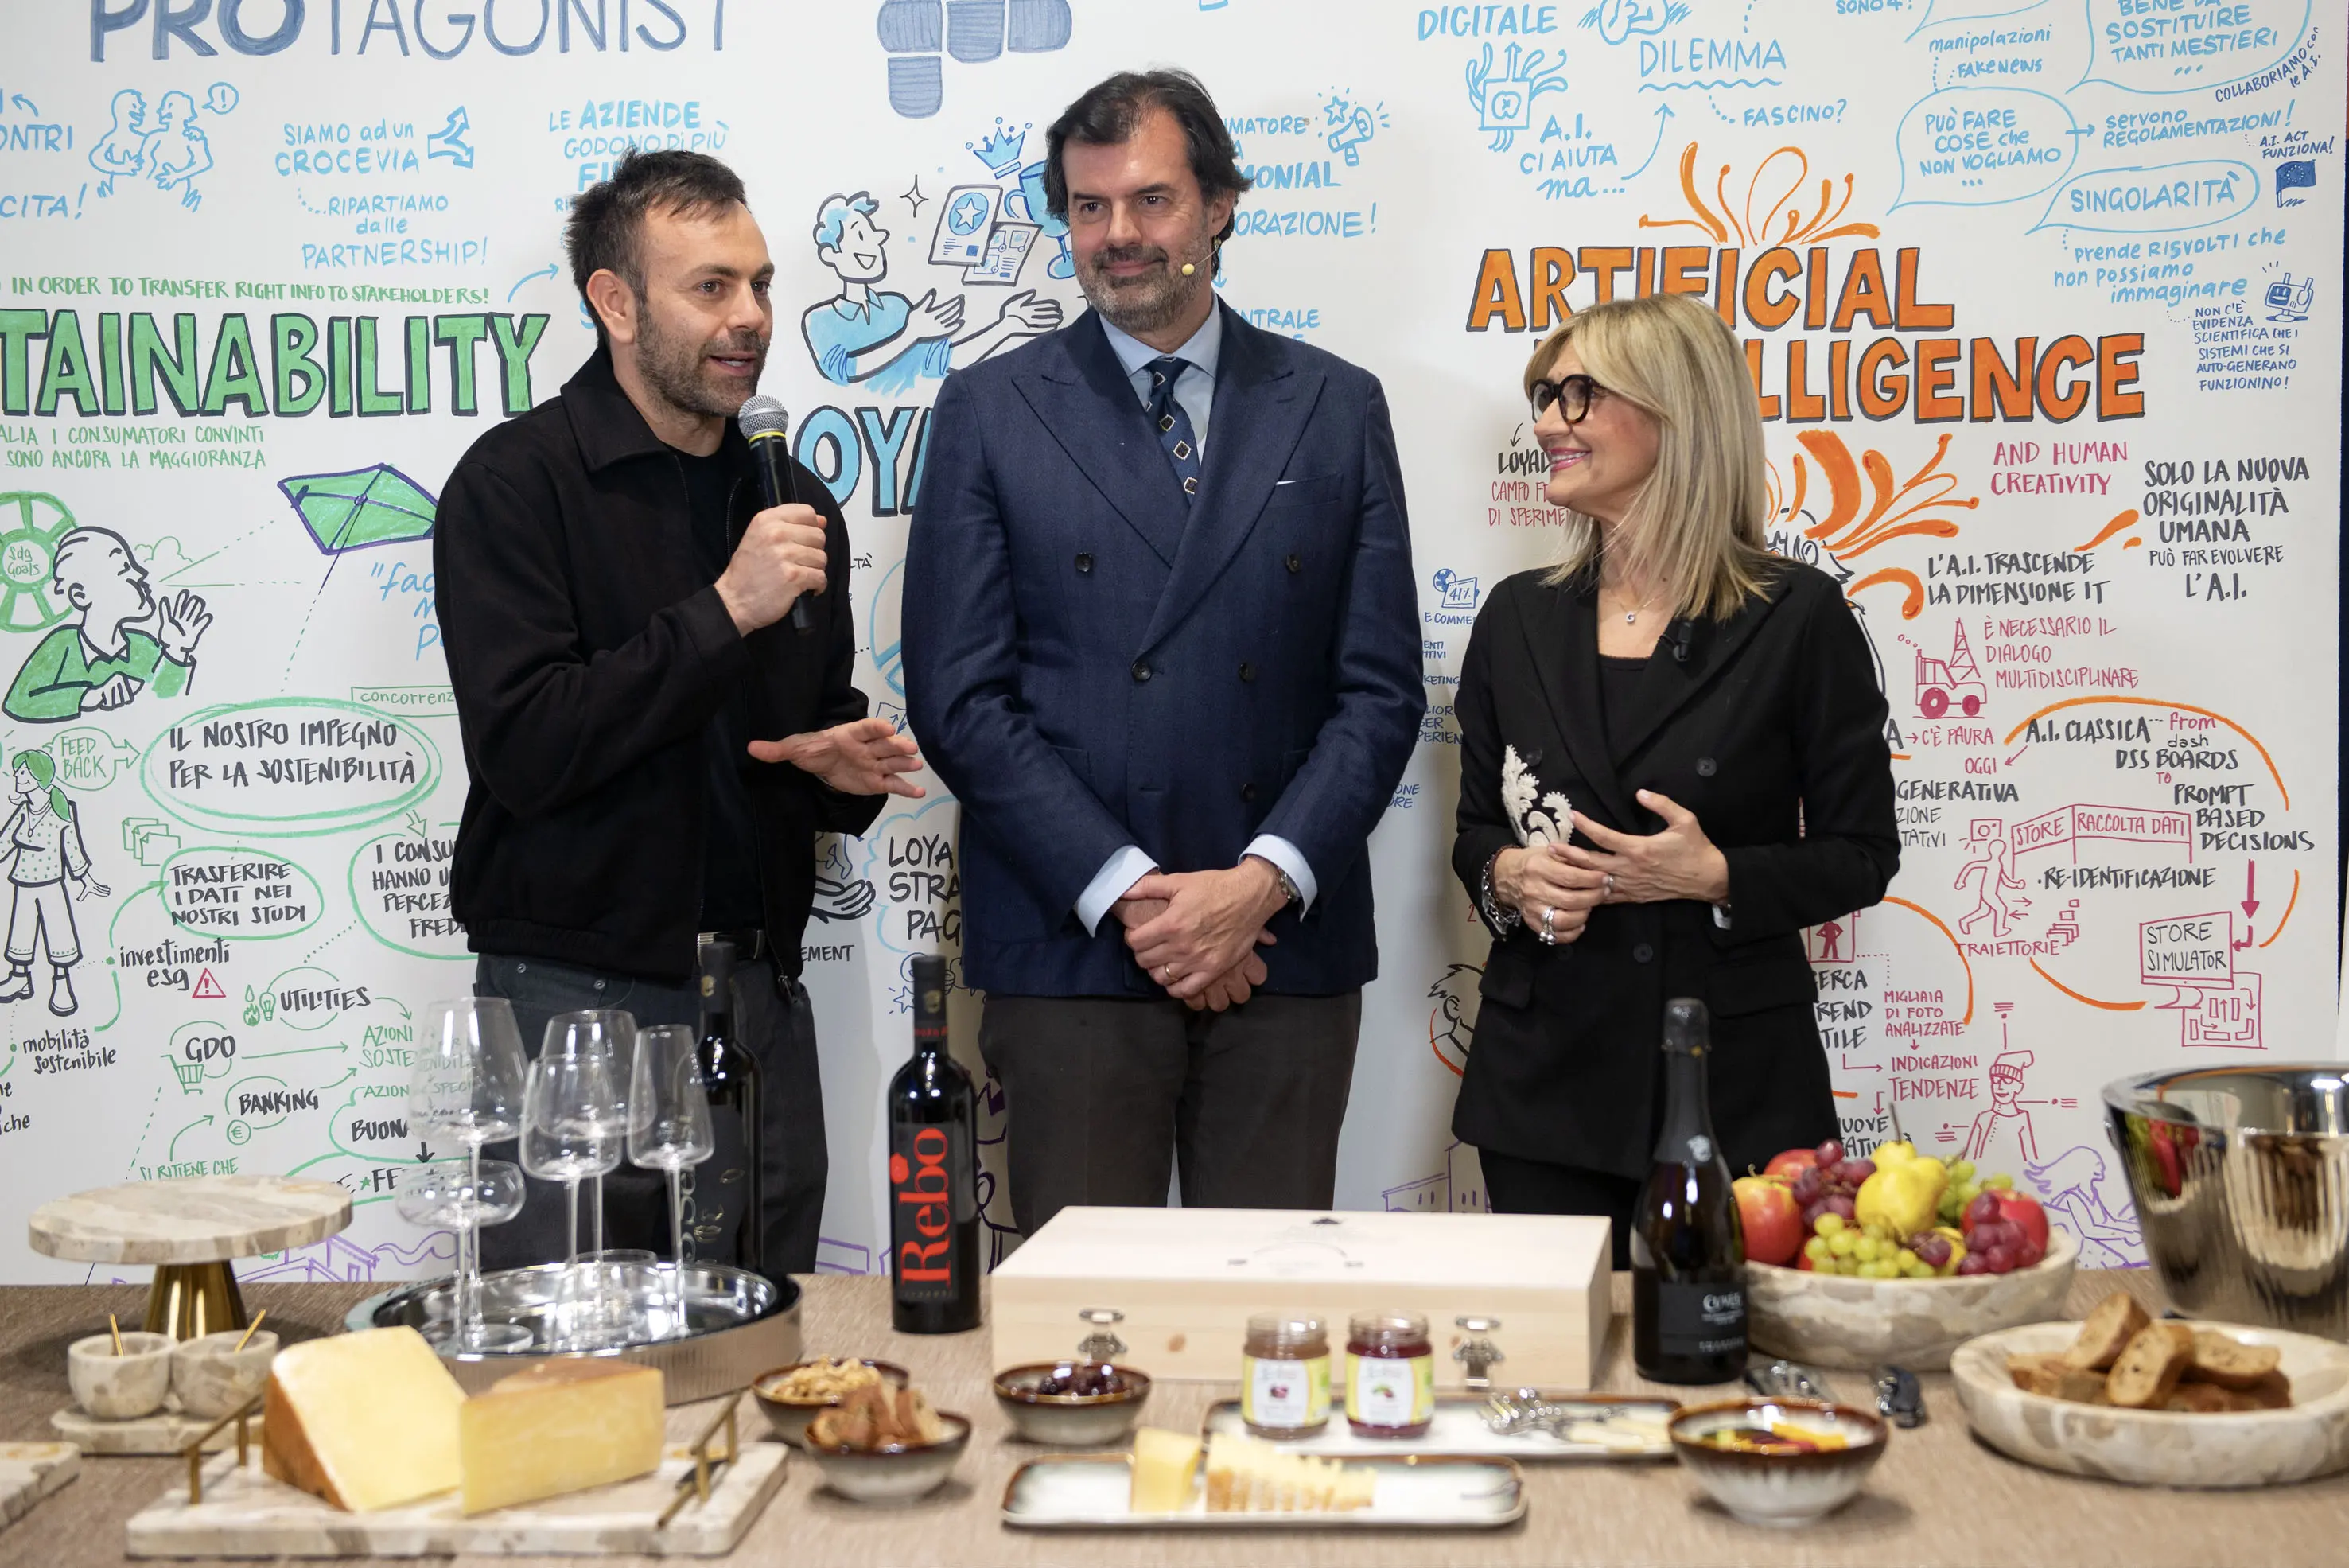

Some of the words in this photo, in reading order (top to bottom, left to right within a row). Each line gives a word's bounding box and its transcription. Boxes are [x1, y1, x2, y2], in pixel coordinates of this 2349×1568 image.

[1418, 6, 1558, 41] DIGITALE
[2106, 5, 2252, 45] SOSTITUIRE
[1929, 23, 2052, 54] manipolazioni
[2111, 43, 2164, 63] TANTI
[2171, 27, 2278, 57] MESTIERI
[1640, 38, 1787, 78] DILEMMA
[2215, 47, 2307, 102] COLLABORIAMO
[549, 110, 571, 132] LE
[579, 99, 701, 130] AZIENDE
[1744, 99, 1847, 126] FASCINO?
[1925, 106, 1958, 134] PUÒ
[1963, 108, 2016, 130] FARE
[2106, 109, 2187, 130] servono
[284, 123, 350, 146] SIAMO
[360, 118, 387, 142] ad
[393, 121, 414, 139] un
[1540, 113, 1593, 144] A.I.
[2284, 130, 2308, 143] ACT
[1935, 131, 1993, 154] COSE
[1998, 129, 2029, 146] che
[2262, 135, 2335, 159] FUNZIONA!
[275, 147, 420, 177] CROCEVIA
[1520, 152, 1544, 175] CI
[1551, 144, 1618, 172] AIUTA
[1919, 158, 1954, 177] NON
[1962, 147, 2062, 171] VOGLIAMO
[2070, 170, 2240, 214] SINGOLARITÀ
[356, 218, 408, 235] dalle
[302, 236, 488, 269] PARTNERSHIP!
[2075, 242, 2141, 263] prende
[2148, 232, 2239, 260] RISVOLTI
[2248, 227, 2286, 247] che
[2055, 269, 2088, 288] non
[12, 277, 33, 294] IN
[39, 277, 101, 295] ORDER
[108, 277, 134, 296] TO
[138, 277, 229, 299] TRANSFER
[235, 282, 286, 301] RIGHT
[291, 283, 325, 302] INFO
[328, 286, 348, 302] TO
[352, 284, 489, 305] STAKEHOLDERS!
[2111, 278, 2248, 308] immaginare
[2192, 316, 2254, 331] EVIDENZA
[2195, 306, 2220, 318] NON
[2194, 328, 2269, 344] SCIENTIFICA
[2273, 327, 2292, 339] CHE
[2199, 344, 2248, 360] SISTEMI
[2252, 345, 2275, 356] CHE
[2279, 344, 2289, 356] SI
[2196, 359, 2297, 374] AUTO-GENERANO
[68, 426, 185, 445] CONSUMATORI
[6, 450, 44, 469] SONO
[52, 449, 111, 469] ANCORA
[120, 450, 140, 469] LA
[149, 449, 266, 469] MAGGIORANZA
[1993, 442, 2040, 466] AND
[2052, 441, 2129, 465] HUMAN
[2144, 460, 2194, 488] SOLO
[2204, 458, 2230, 484] LA
[2237, 457, 2310, 483] NUOVA
[1492, 481, 1529, 503] CAMPO
[2143, 487, 2289, 518] ORIGINALITÀ
[1488, 508, 1500, 527] DI
[2160, 519, 2251, 544] UMANA
[1984, 551, 2095, 574] TRASCENDE
[2149, 548, 2175, 567] PUÒ
[2182, 549, 2208, 566] FAR
[2211, 545, 2285, 566] EVOLVERE
[1928, 583, 1951, 606] LA
[1957, 581, 2075, 607] DIMENSIONE
[2084, 580, 2111, 605] IT
[1425, 612, 1476, 625] E-COMME
[1999, 617, 2090, 637] NECESSARIO
[2098, 616, 2117, 635] IL
[1985, 644, 2051, 663] DIALOGO
[169, 728, 191, 751] IL
[204, 722, 289, 750] NOSTRO
[301, 719, 397, 750] IMPEGNO
[1947, 726, 1994, 745] PAURA
[2025, 718, 2059, 743] A.I.
[2066, 716, 2151, 744] CLASSICA
[2168, 734, 2209, 748] dash
[60, 737, 96, 756] FEED
[63, 755, 107, 780] BACK
[169, 760, 212, 789] PER
[222, 764, 248, 788] LA
[257, 752, 416, 786] SOSTENIBILITÀ
[1964, 757, 1997, 775] OGGI
[2116, 749, 2149, 769] DSS
[2156, 749, 2238, 770] BOARDS
[2156, 772, 2172, 784] TO
[2174, 783, 2254, 806] PROMPT
[2016, 816, 2065, 846] STORE
[2077, 812, 2145, 834] RACCOLTA
[2152, 815, 2185, 836] DATI
[2196, 808, 2265, 829] BASED
[395, 838, 457, 863] CONSU
[2200, 830, 2316, 852] DECISIONS
[169, 862, 291, 885] TRASFERIRE
[372, 867, 431, 891] HANNO
[189, 885, 239, 906] DATI
[255, 885, 292, 901] NEI
[171, 905, 238, 927] NOSTRI
[252, 904, 305, 924] STUDI
[2147, 922, 2212, 944] STORE
[119, 938, 231, 967] investimenti
[1955, 940, 2061, 957] TRAIETTORIE
[2148, 950, 2227, 972] SIMULATOR
[147, 967, 189, 991] esg
[1884, 990, 1943, 1003] MIGLIAIA
[1886, 1007, 1900, 1019] DI
[1908, 1007, 1943, 1018] FOTO
[363, 1025, 413, 1047] AZIONI
[1886, 1021, 1966, 1037] ANALIZZATE
[22, 1029, 89, 1054] mobilità
[185, 1035, 236, 1063] GDO
[34, 1046, 117, 1075] sostenibile
[1892, 1055, 1978, 1072] INDICAZIONI
[1888, 1076, 1979, 1102] TENDENZE
[239, 1088, 318, 1116] BANKING
[213, 1157, 239, 1175] CHE
[899, 1126, 951, 1290] Rebo
